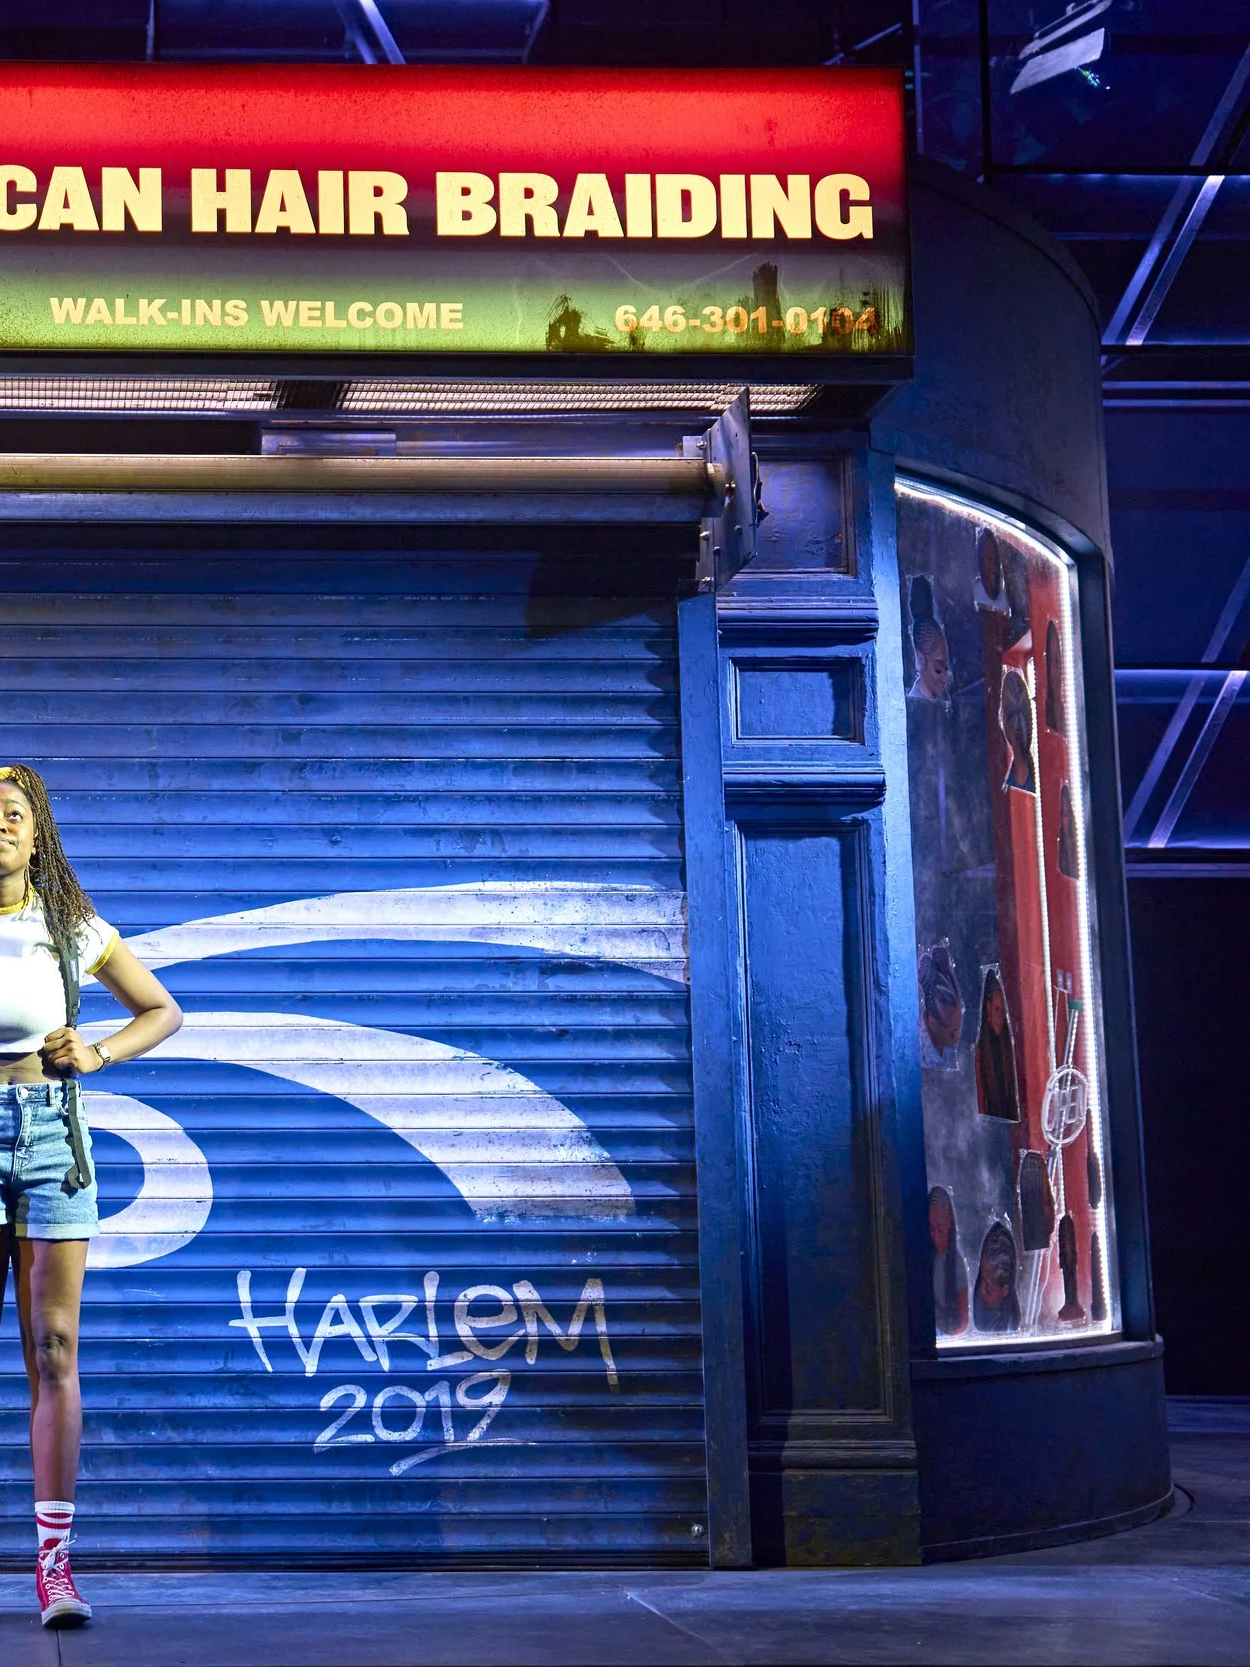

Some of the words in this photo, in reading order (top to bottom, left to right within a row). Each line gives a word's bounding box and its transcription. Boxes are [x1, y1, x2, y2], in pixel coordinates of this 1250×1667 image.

[190, 168, 409, 235] HAIR
[435, 171, 874, 240] BRAIDING
[50, 297, 248, 327] WALK-INS
[260, 299, 464, 330] WELCOME
[614, 304, 878, 334] 646-301-0104
[313, 1368, 512, 1453] 2019
